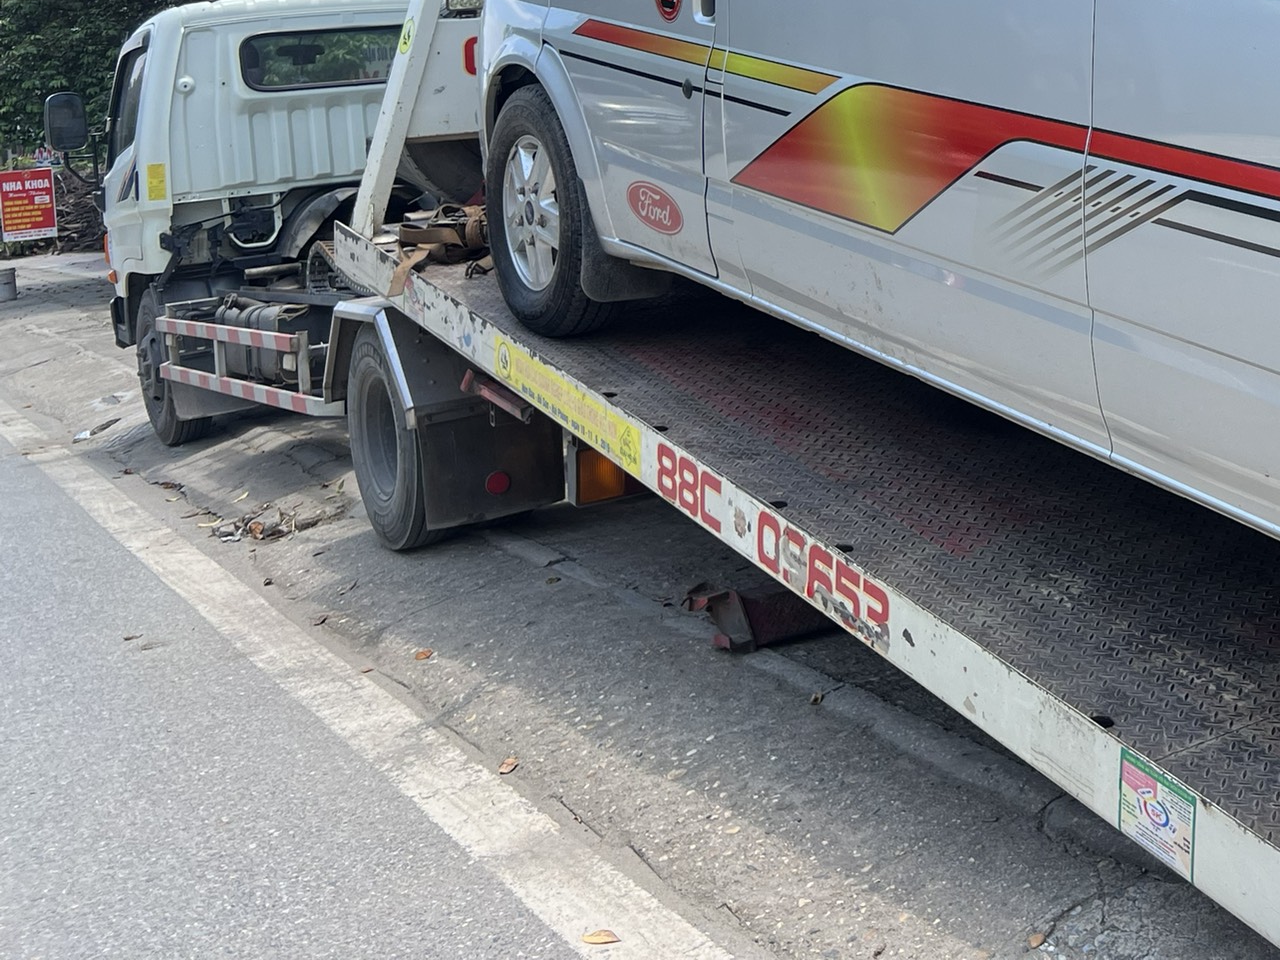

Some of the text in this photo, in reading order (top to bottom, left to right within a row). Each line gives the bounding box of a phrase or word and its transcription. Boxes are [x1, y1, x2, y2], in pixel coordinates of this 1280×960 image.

[2, 179, 50, 192] NHA KHOA
[638, 187, 672, 227] Ford
